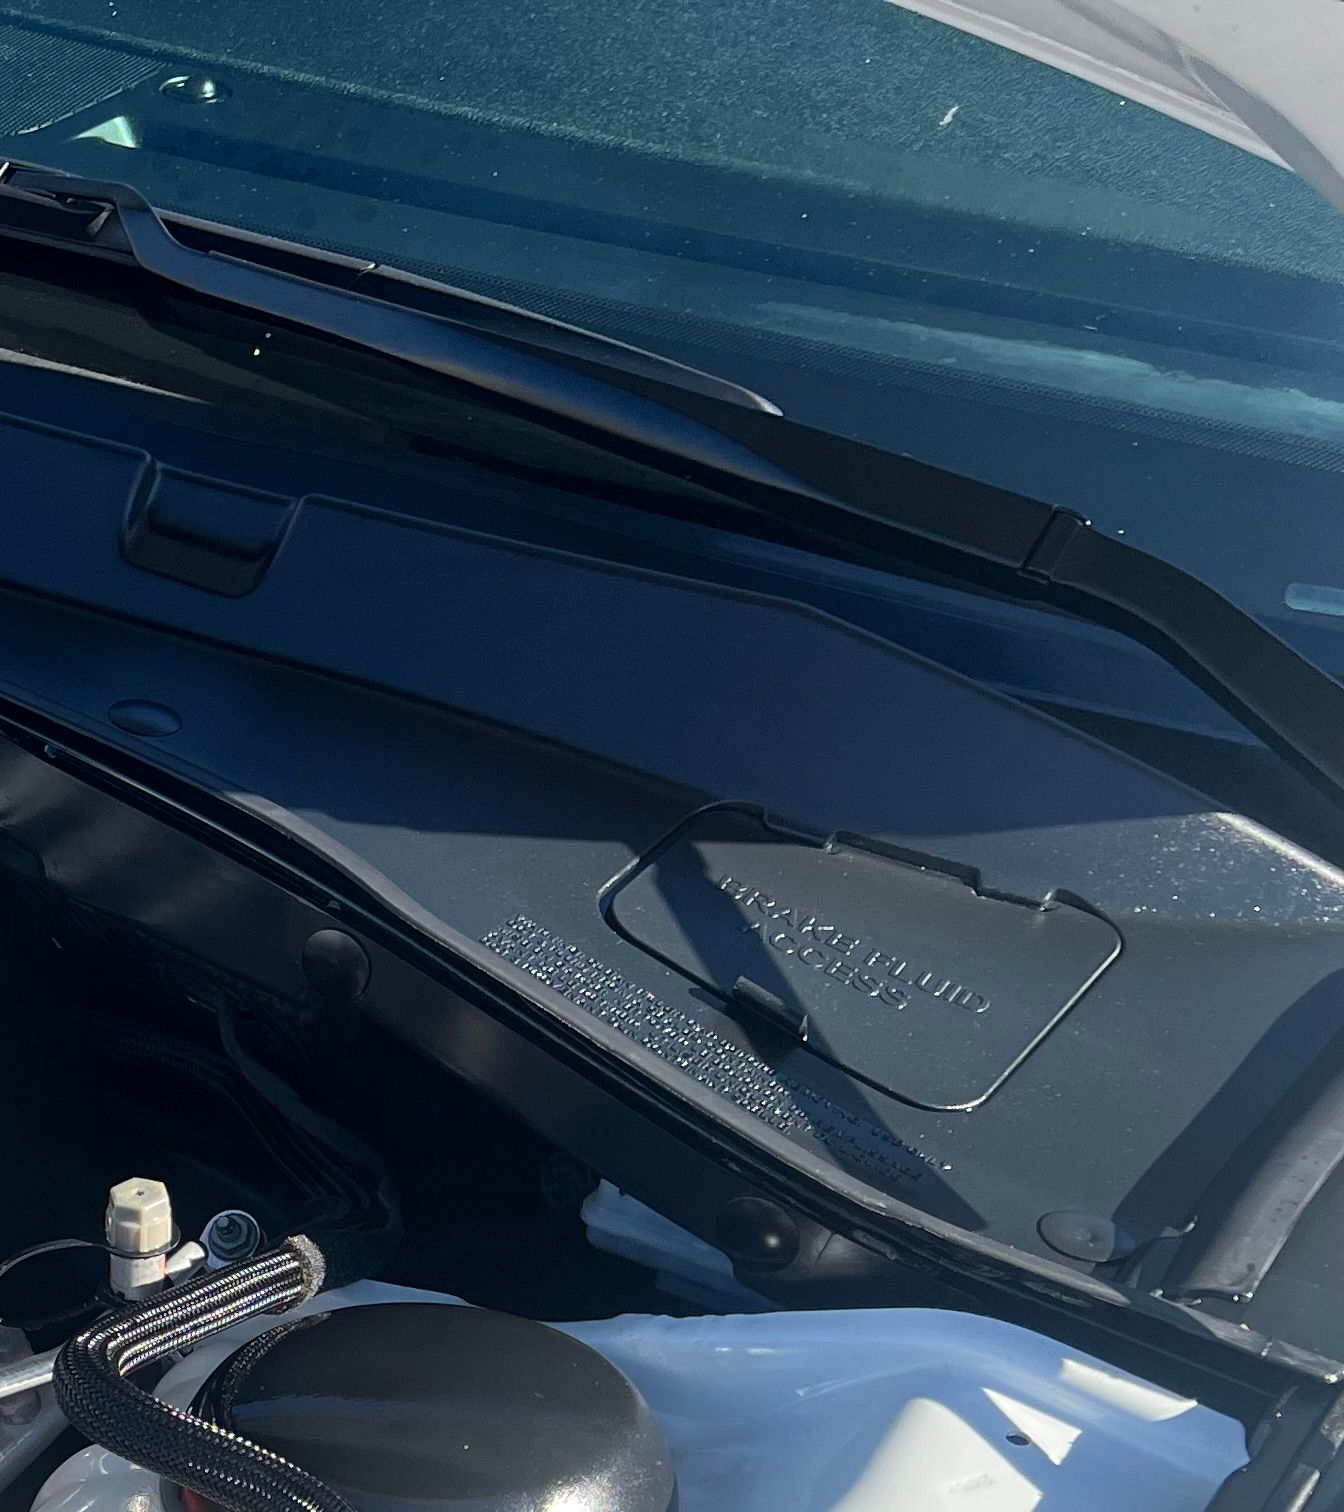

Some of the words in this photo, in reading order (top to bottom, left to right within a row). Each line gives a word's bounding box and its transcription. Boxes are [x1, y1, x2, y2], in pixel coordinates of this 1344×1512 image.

[718, 873, 861, 957] BRAKE
[863, 947, 992, 1014] FLUID
[738, 921, 910, 1011] ACCESS
